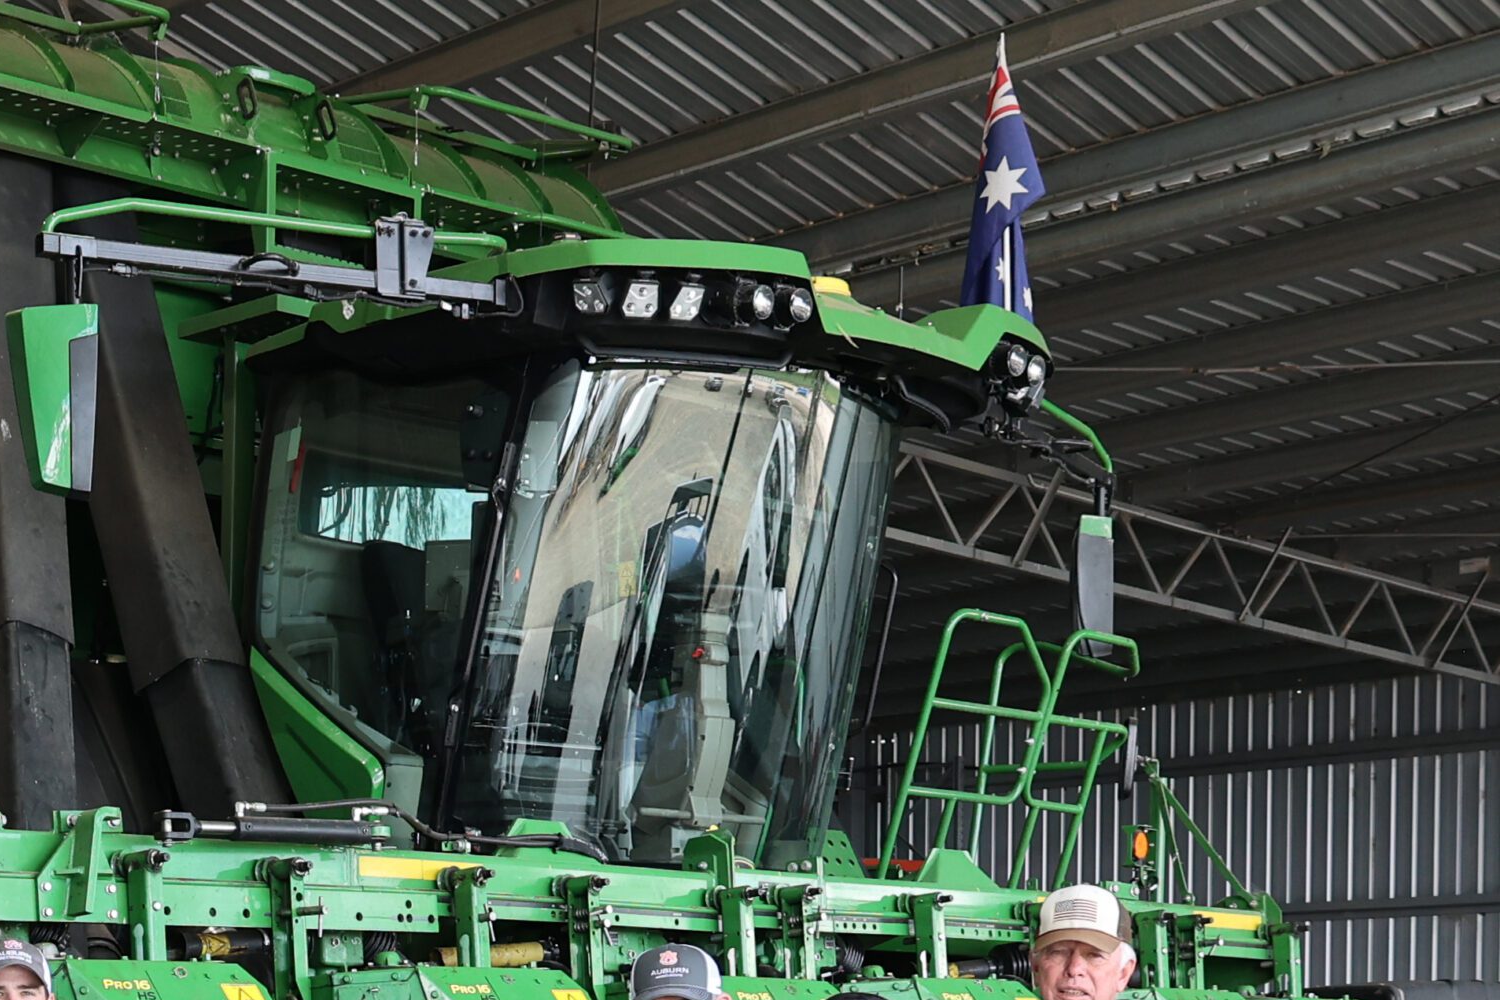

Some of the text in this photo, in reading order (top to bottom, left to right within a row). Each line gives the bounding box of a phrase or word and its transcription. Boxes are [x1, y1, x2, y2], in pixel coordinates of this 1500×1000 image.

[650, 967, 689, 976] AUBURN
[133, 979, 151, 990] 16
[137, 991, 157, 1000] HS
